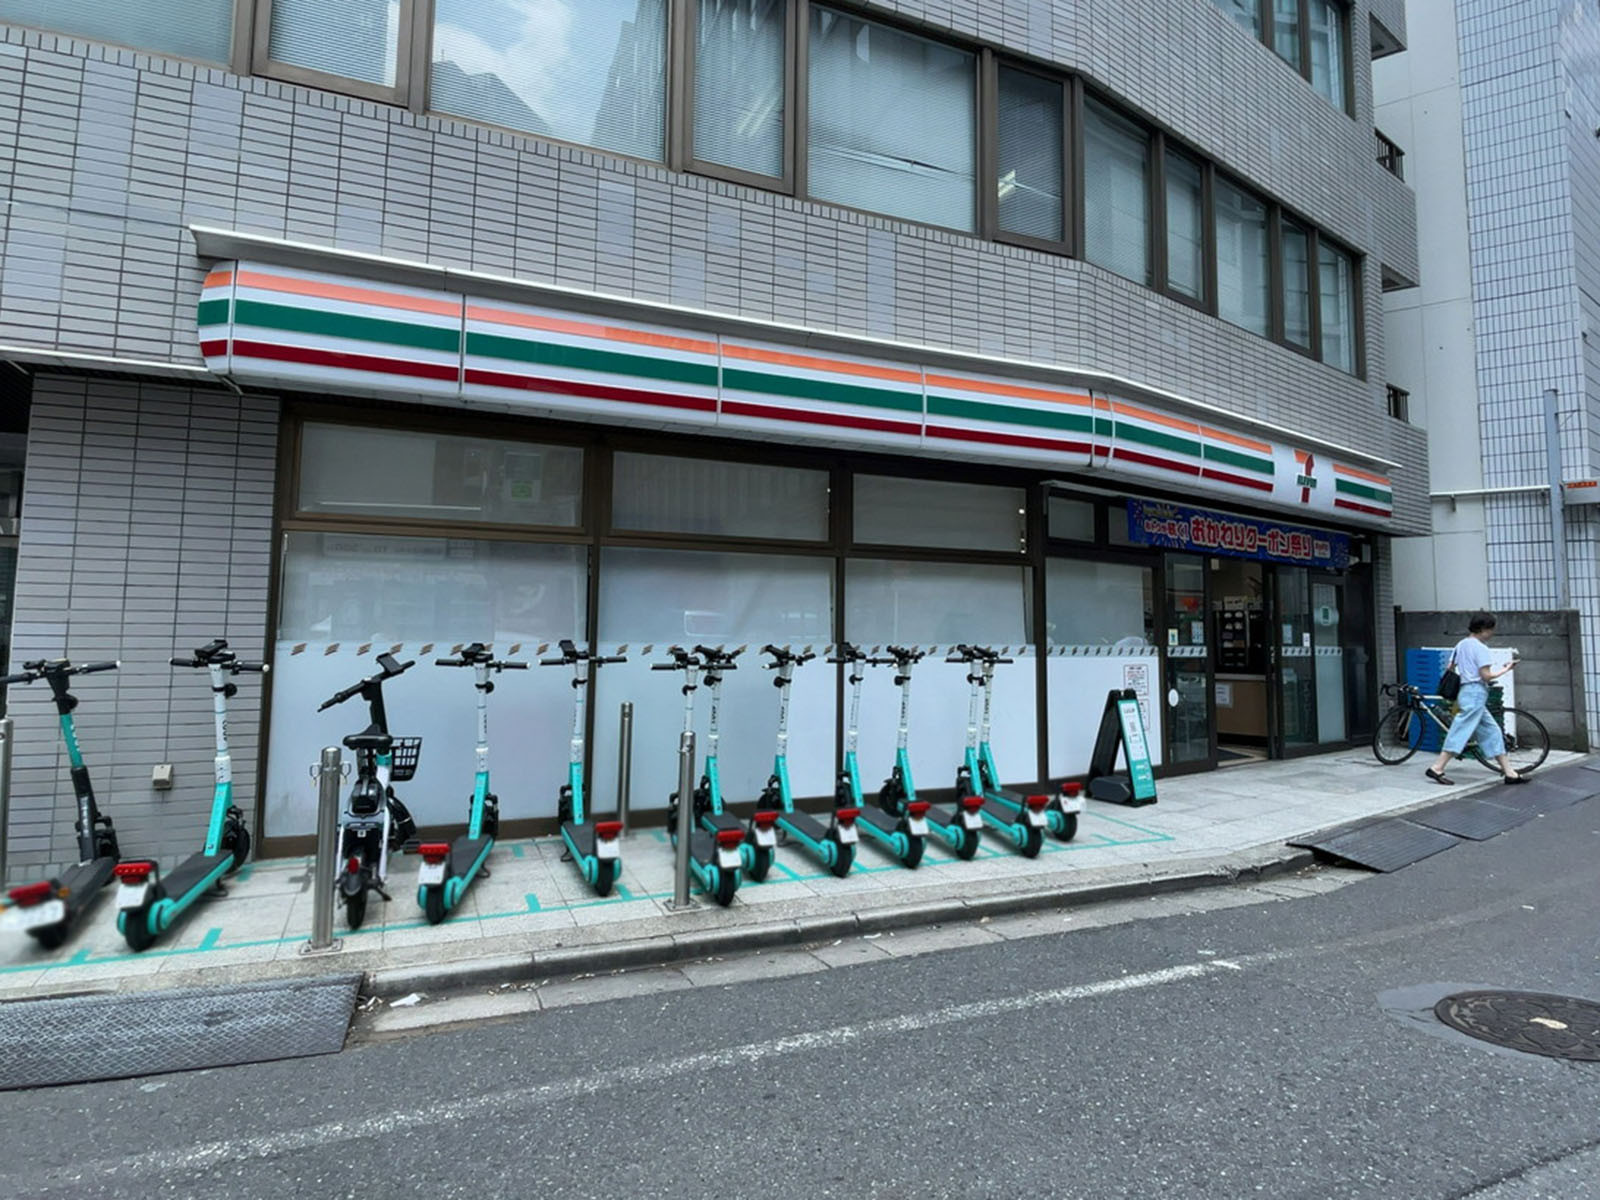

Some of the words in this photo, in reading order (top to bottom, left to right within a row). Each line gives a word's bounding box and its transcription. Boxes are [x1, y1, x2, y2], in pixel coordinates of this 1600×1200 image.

[1190, 516, 1313, 559] おかわりクーポン祭り
